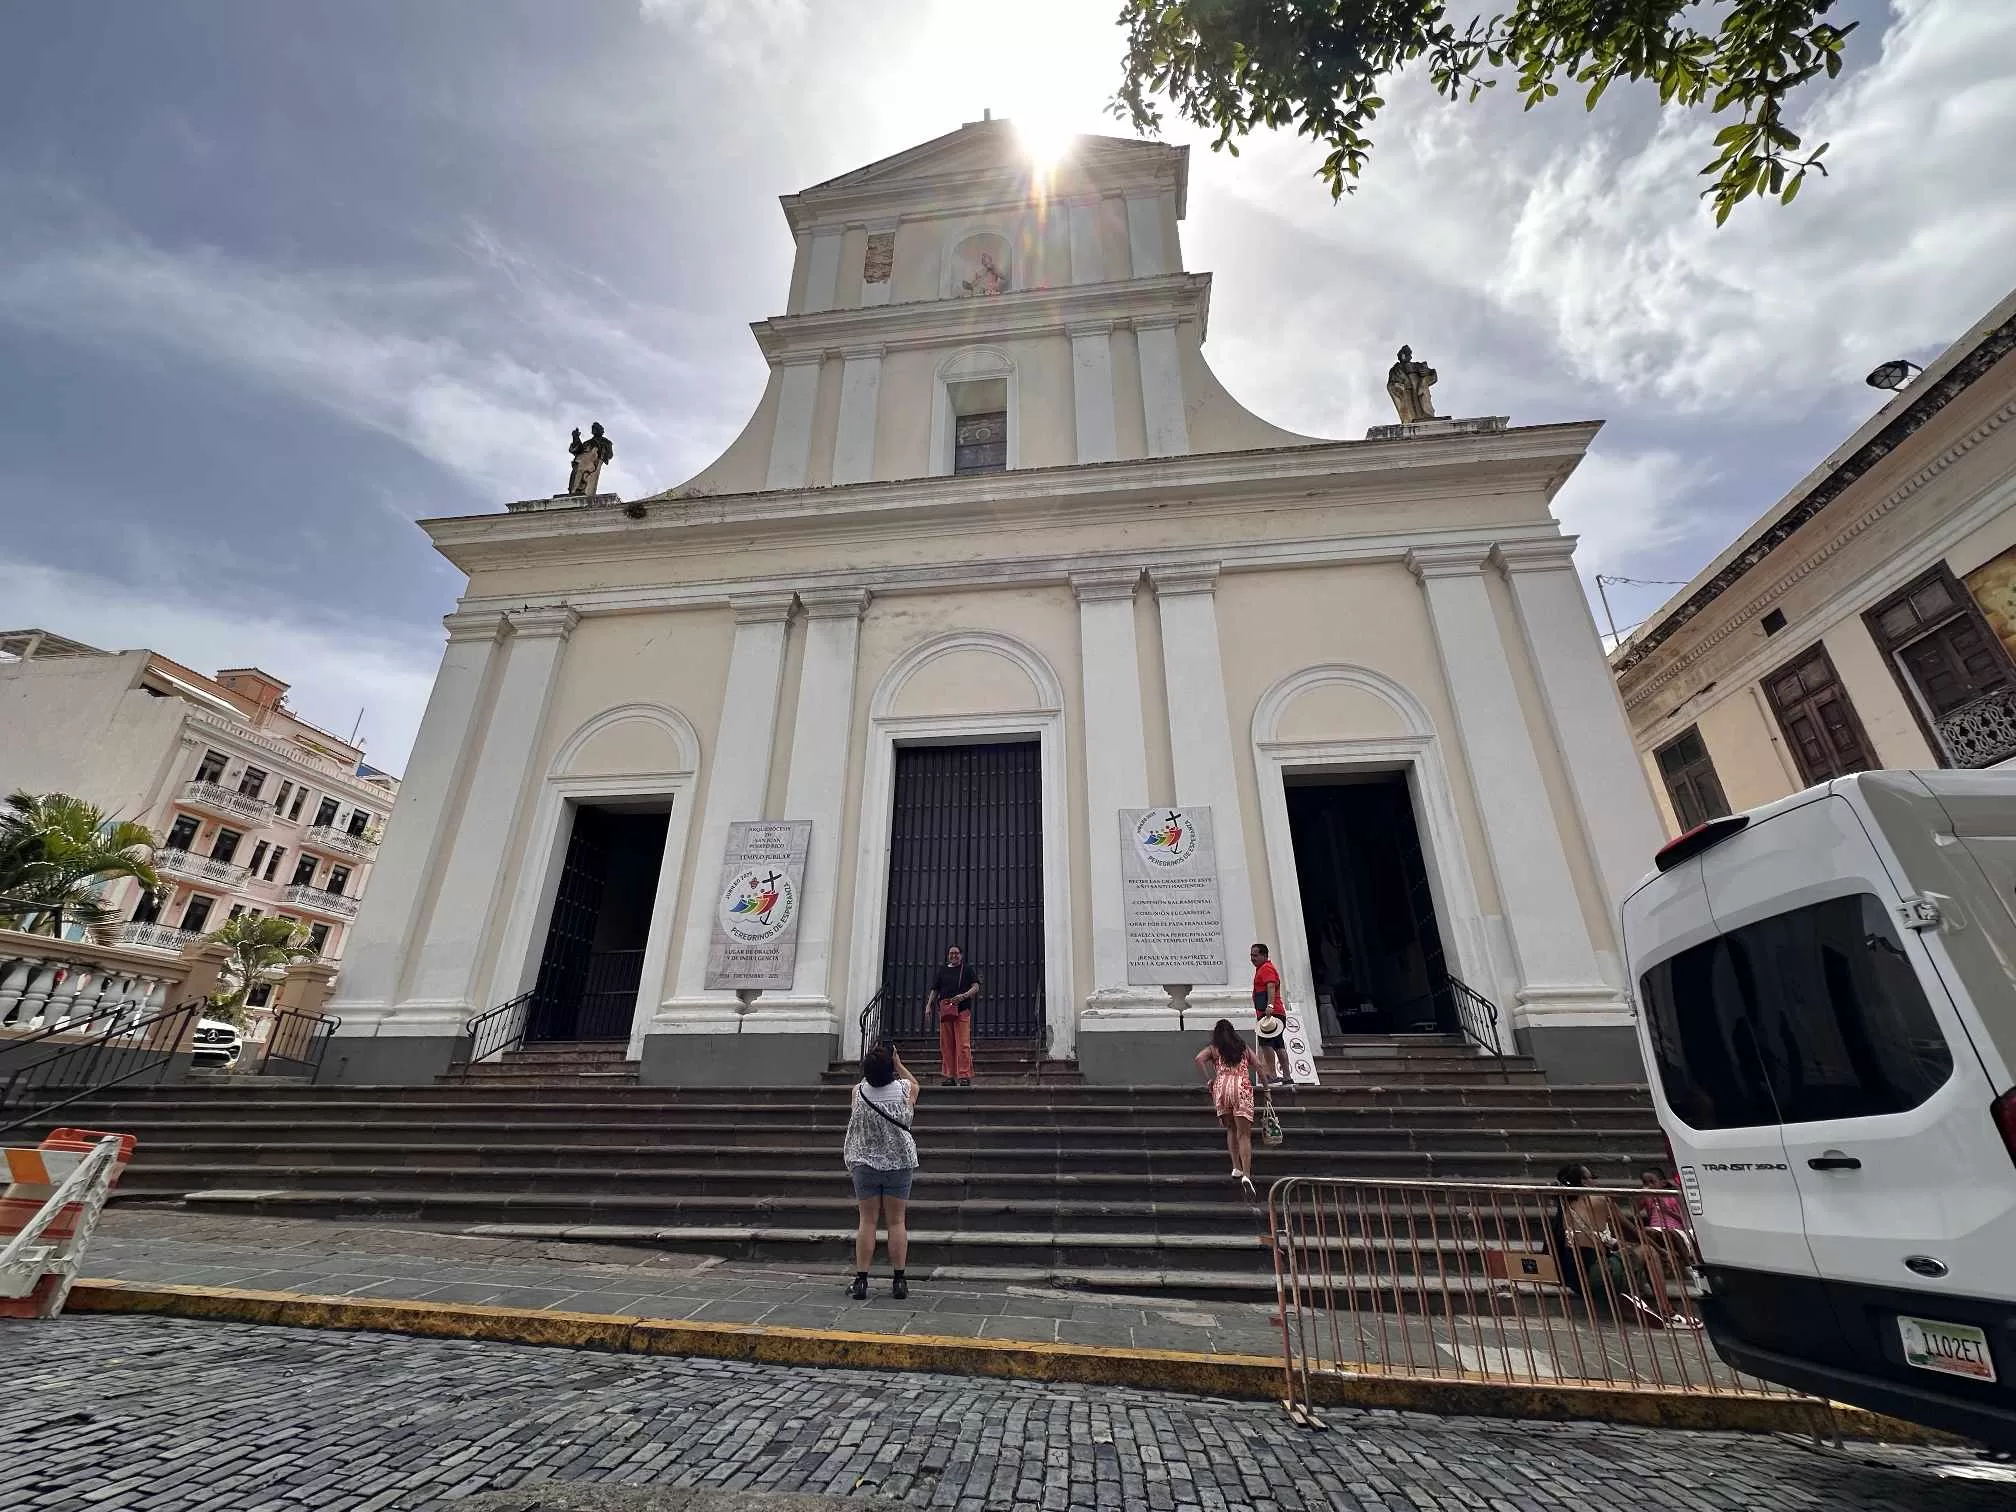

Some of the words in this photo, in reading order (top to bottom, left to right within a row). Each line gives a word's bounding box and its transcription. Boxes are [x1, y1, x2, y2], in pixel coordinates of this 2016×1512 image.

[731, 926, 774, 941] PEREGRINOS
[774, 920, 783, 933] DE
[1702, 1163, 1753, 1171] TRANSIT
[1922, 1332, 1984, 1364] 1102ET
